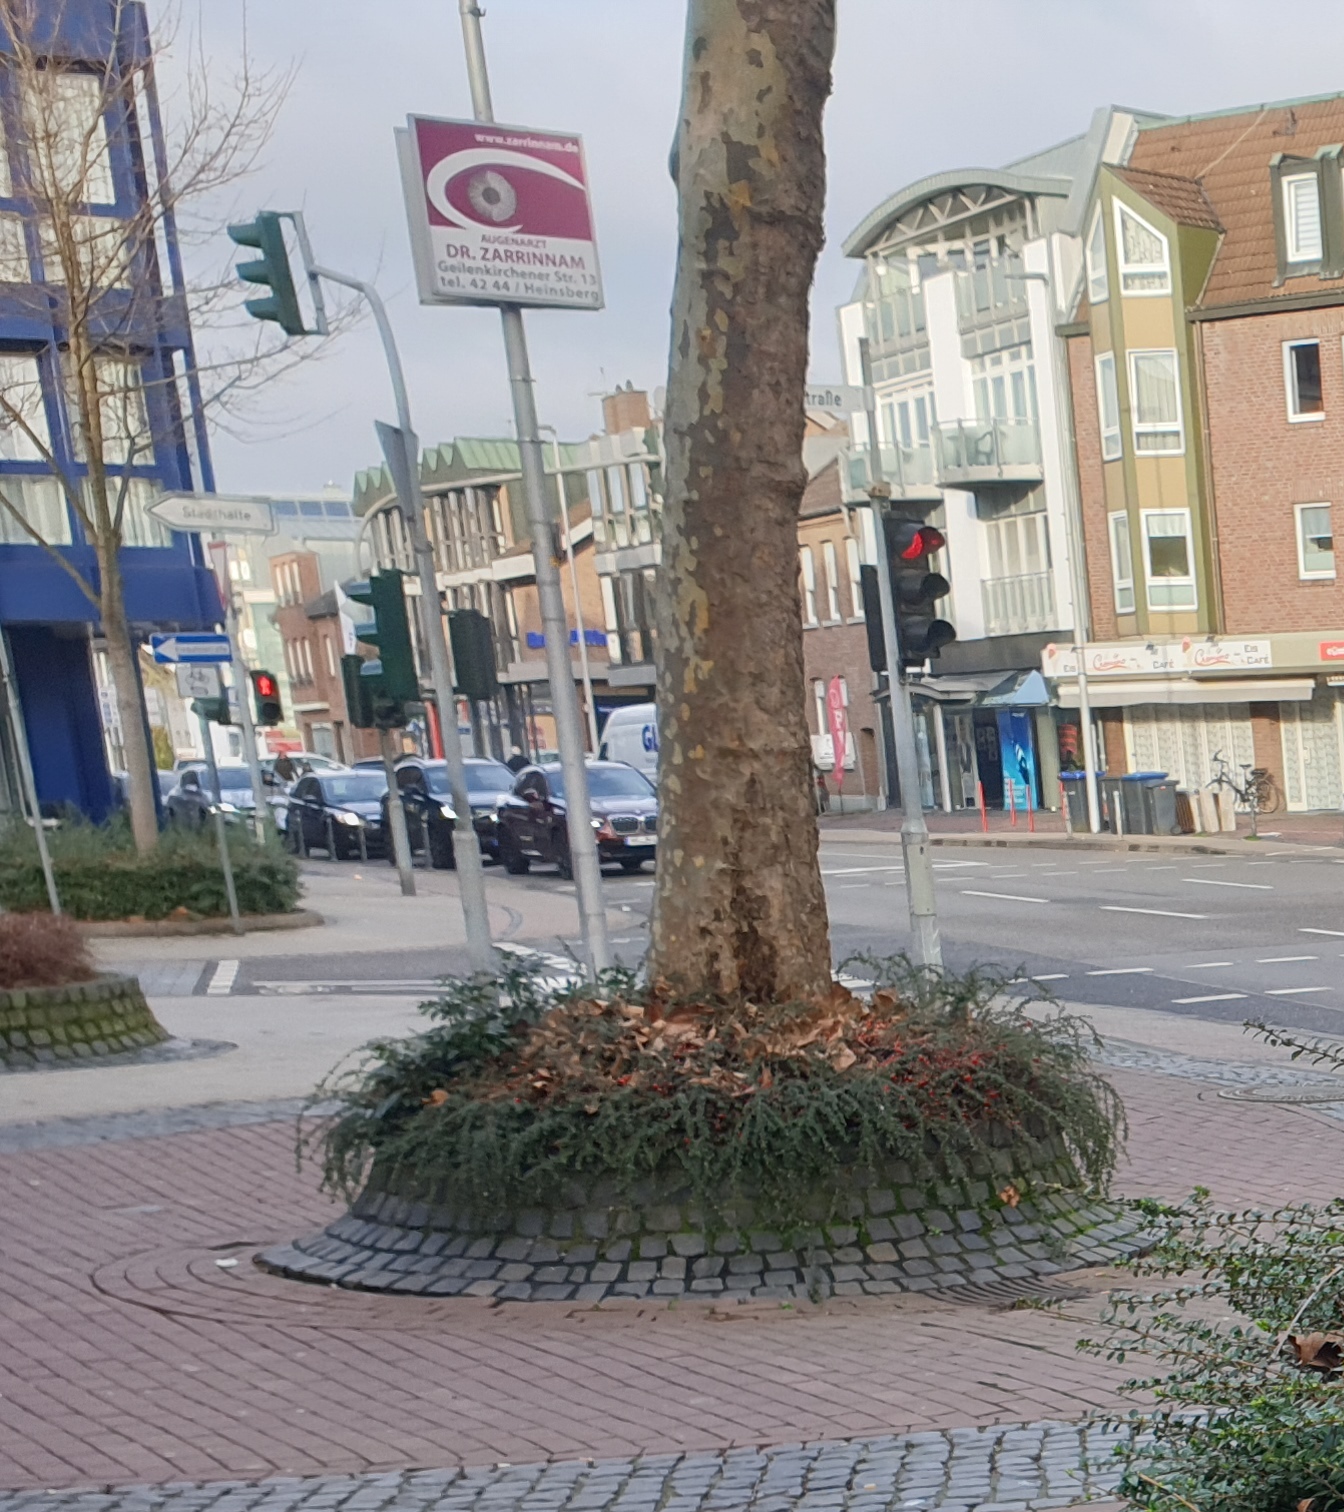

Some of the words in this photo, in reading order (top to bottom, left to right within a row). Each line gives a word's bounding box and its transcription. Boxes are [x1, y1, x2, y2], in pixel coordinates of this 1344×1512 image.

[481, 234, 547, 248] AUGENARZT
[446, 243, 476, 260] DR.
[480, 247, 585, 270] ZARRINNAM
[438, 260, 550, 281] Geilenkirchener
[554, 271, 576, 284] Str.
[582, 274, 597, 285] 13
[440, 276, 465, 288] tel.
[470, 278, 487, 290] 42
[492, 281, 510, 292] 44
[524, 282, 599, 300] Heinsberg
[805, 389, 842, 406] traße
[642, 723, 660, 752] GL
